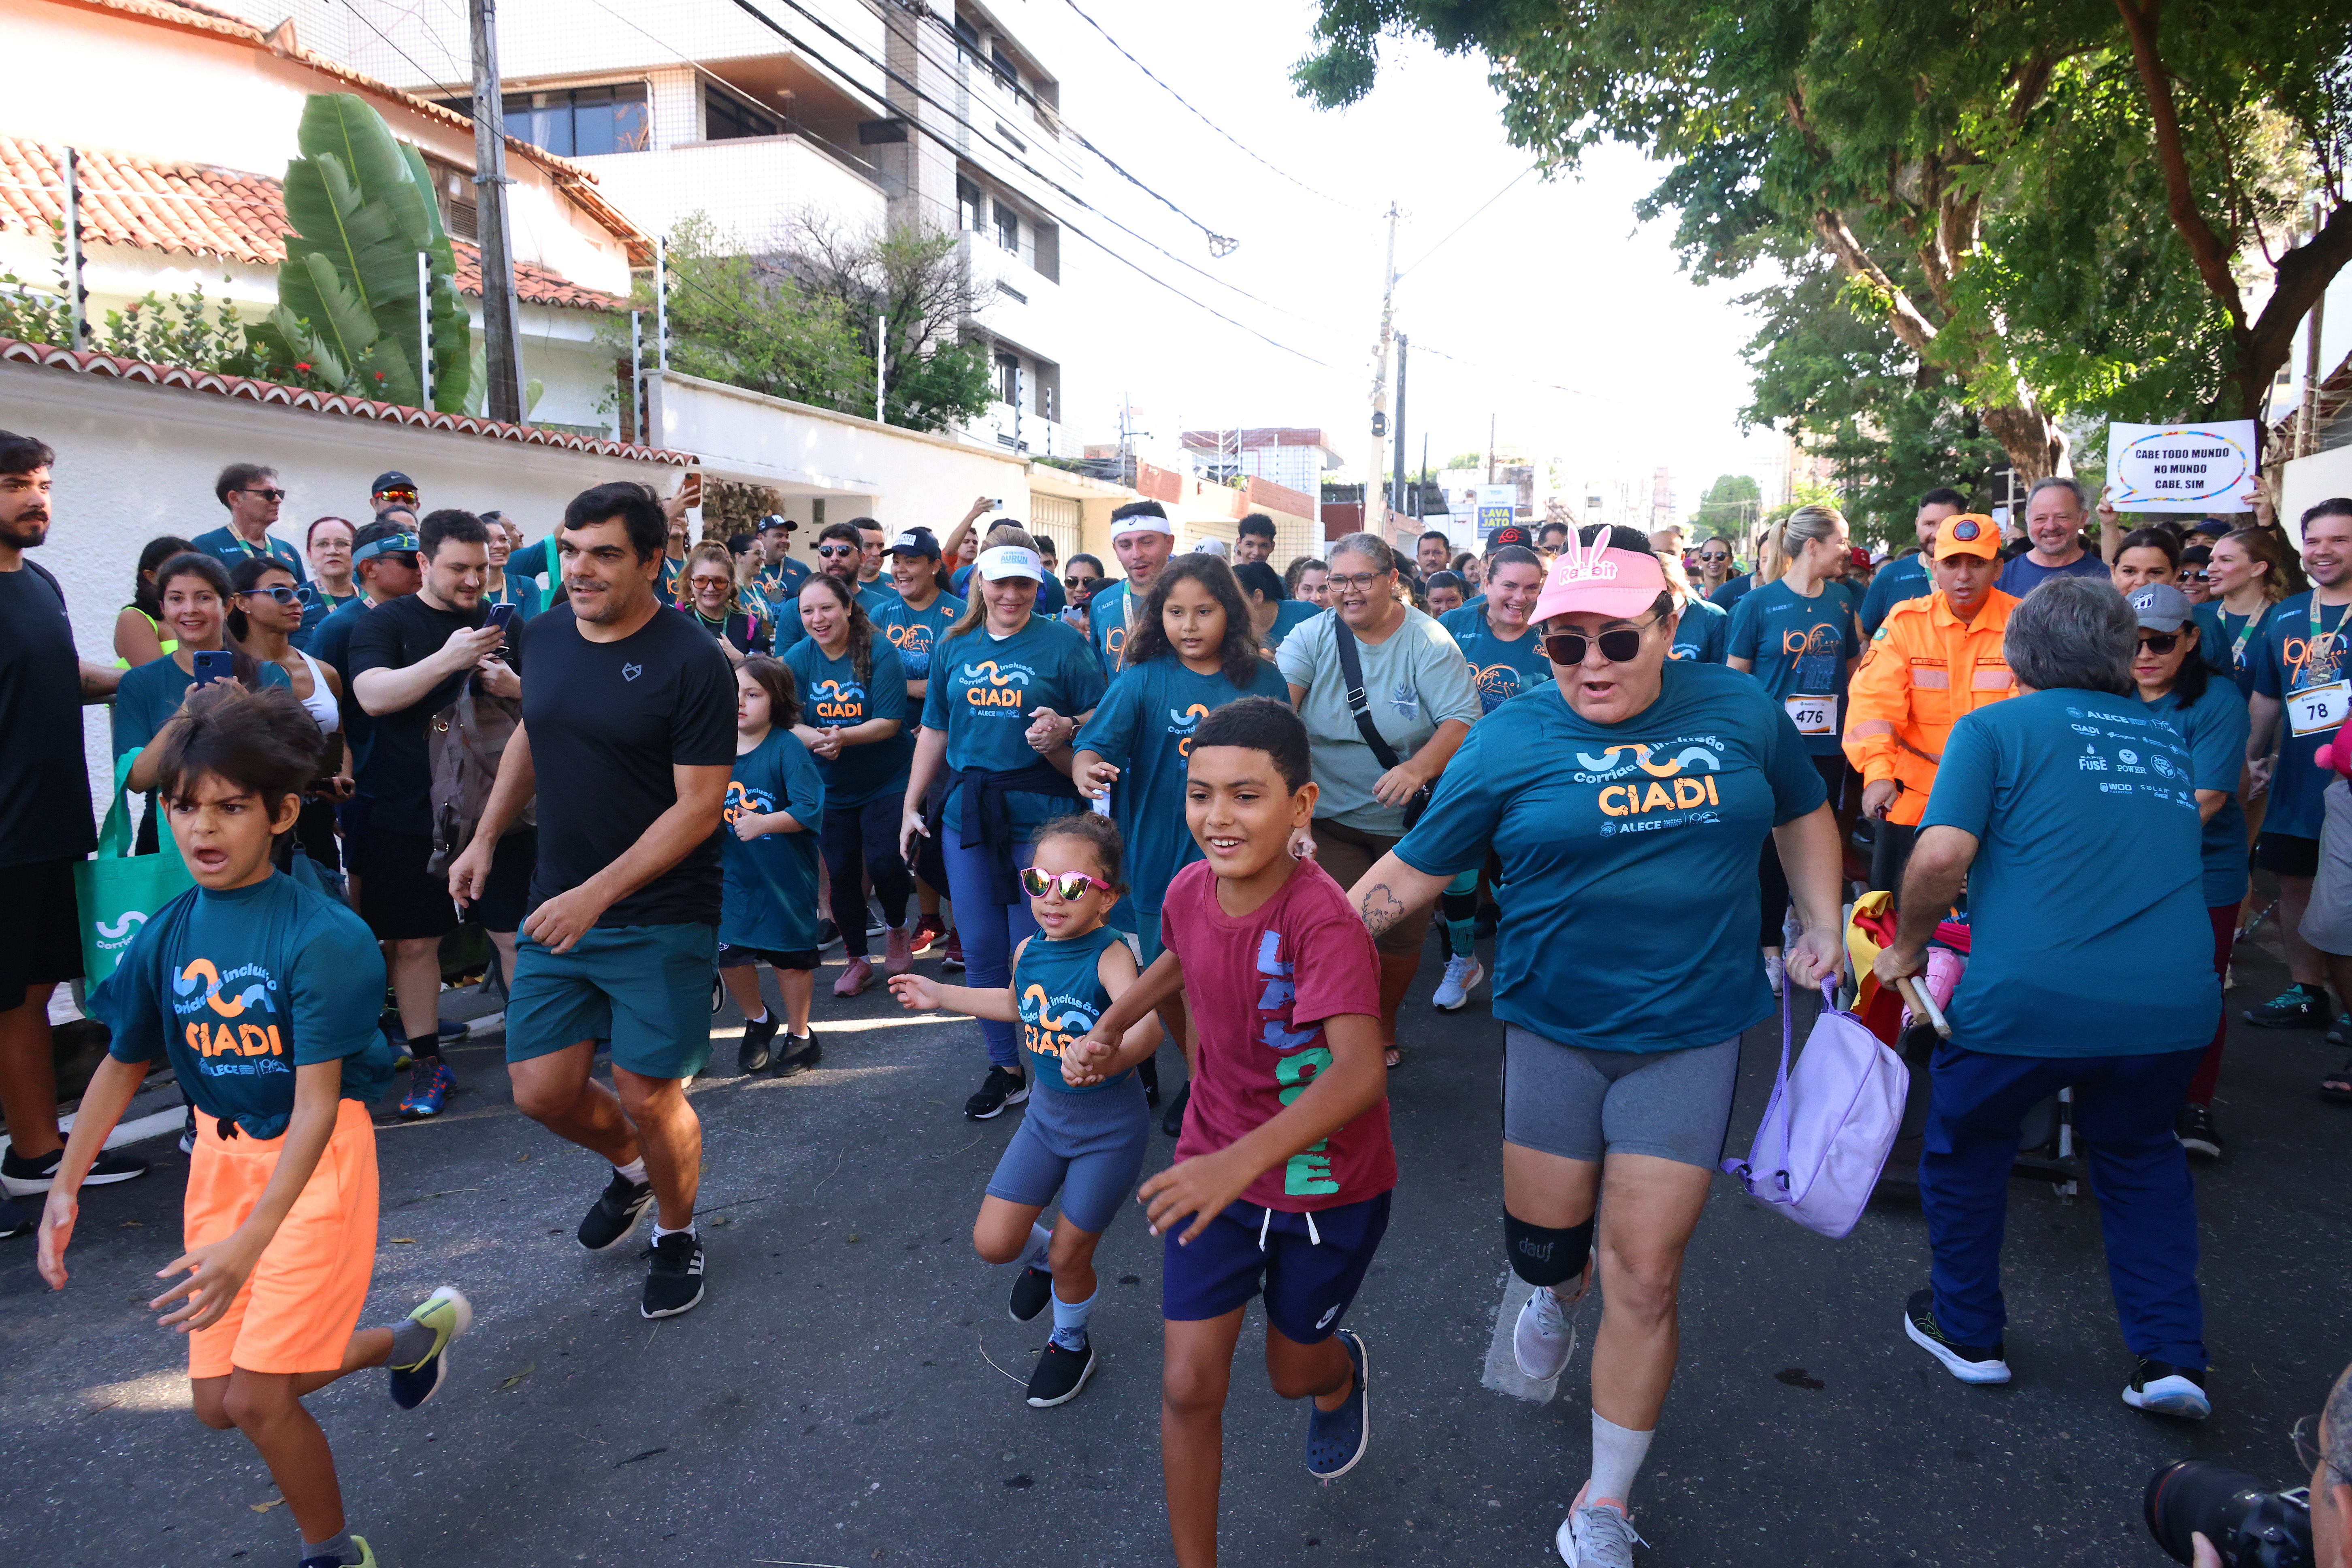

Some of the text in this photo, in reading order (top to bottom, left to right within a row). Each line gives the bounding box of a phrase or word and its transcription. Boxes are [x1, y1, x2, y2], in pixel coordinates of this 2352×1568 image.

[2136, 448, 2229, 458] CABE TODO MUNDO
[2154, 464, 2207, 473] NO MUNDO
[2155, 480, 2204, 489] CABE, SIM
[1482, 508, 1510, 518] LAVA
[1482, 518, 1509, 527] JATO
[1001, 555, 1028, 564] AURUN
[1106, 624, 1127, 672] 19
[959, 675, 989, 685] Corrida
[967, 687, 1022, 707] CIADI
[816, 703, 862, 717] CIADI
[1796, 710, 1823, 723] 476
[2306, 703, 2329, 720] 78
[2088, 711, 2129, 724] ALECE
[1167, 724, 1196, 735] Corrid
[2071, 724, 2101, 735] CIADI
[1574, 764, 1637, 784] Corrida
[1635, 748, 1655, 766] da
[2079, 758, 2108, 770] FUSE
[2116, 765, 2147, 774] POWER
[2108, 783, 2132, 791] WOD
[2140, 784, 2169, 794] SOLAR
[724, 797, 739, 805] rida
[746, 788, 777, 801] inclusão
[1598, 775, 1719, 817] CIADI
[1619, 820, 1662, 833] ALECE
[1039, 1001, 1052, 1016] da
[1049, 994, 1100, 1016] inclusão
[185, 1022, 283, 1058] CIADI
[1024, 1024, 1075, 1058] CIAD
[209, 1064, 239, 1077] LECE
[1519, 1237, 1555, 1263] dauf
